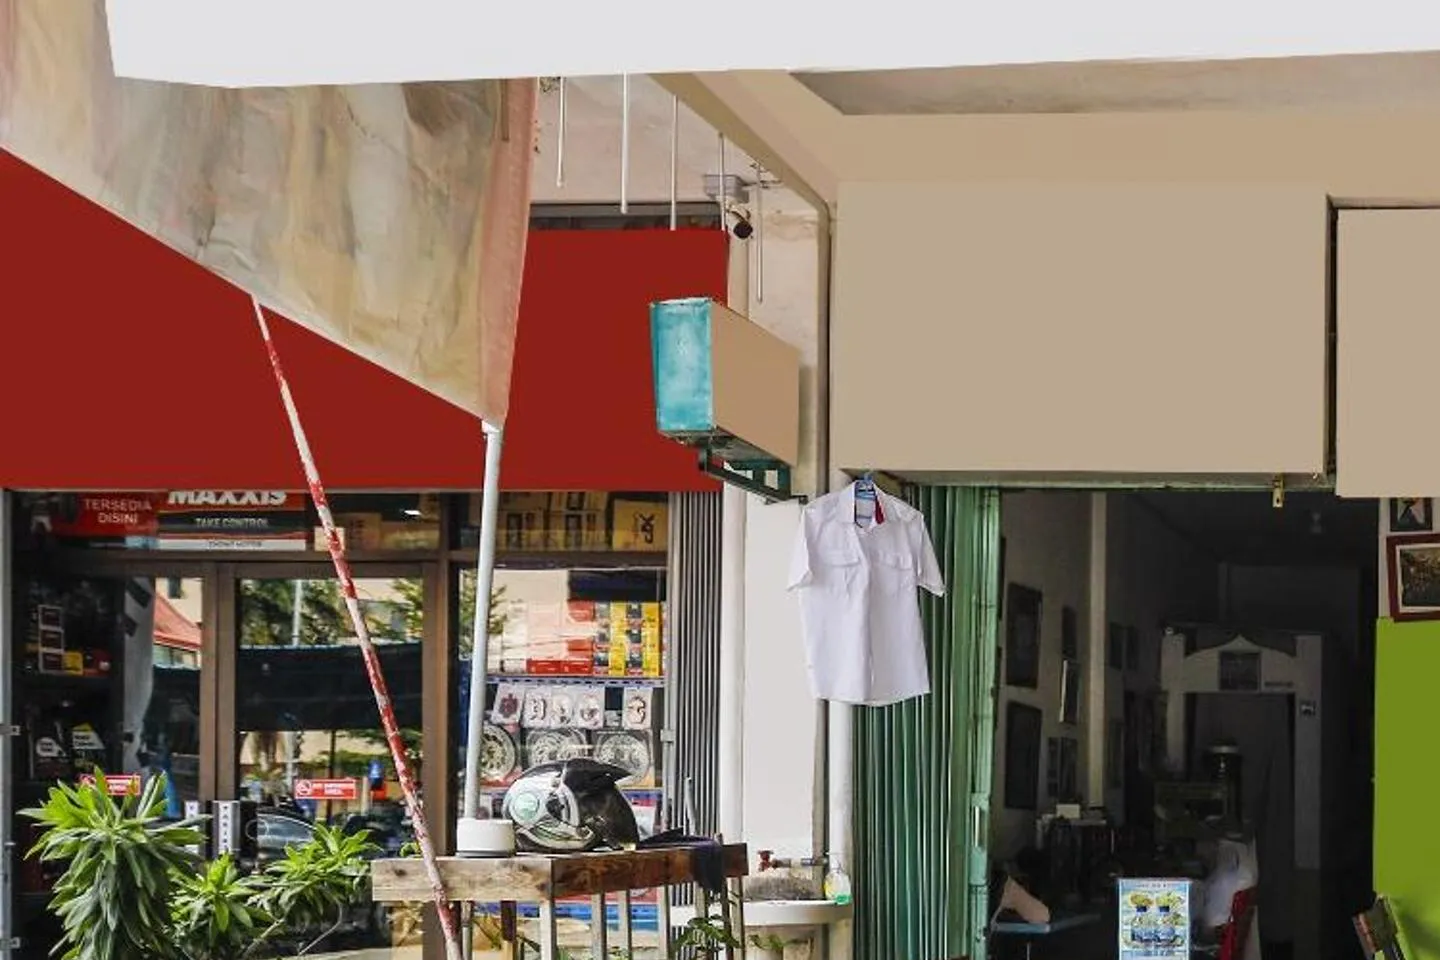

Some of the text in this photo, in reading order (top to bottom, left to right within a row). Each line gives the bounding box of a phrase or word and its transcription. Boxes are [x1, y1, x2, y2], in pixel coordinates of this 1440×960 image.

[168, 490, 287, 505] MAXXIS
[83, 498, 152, 511] TERSEDIA
[97, 512, 138, 524] DISINI
[195, 517, 269, 529] TAKE CONTROL
